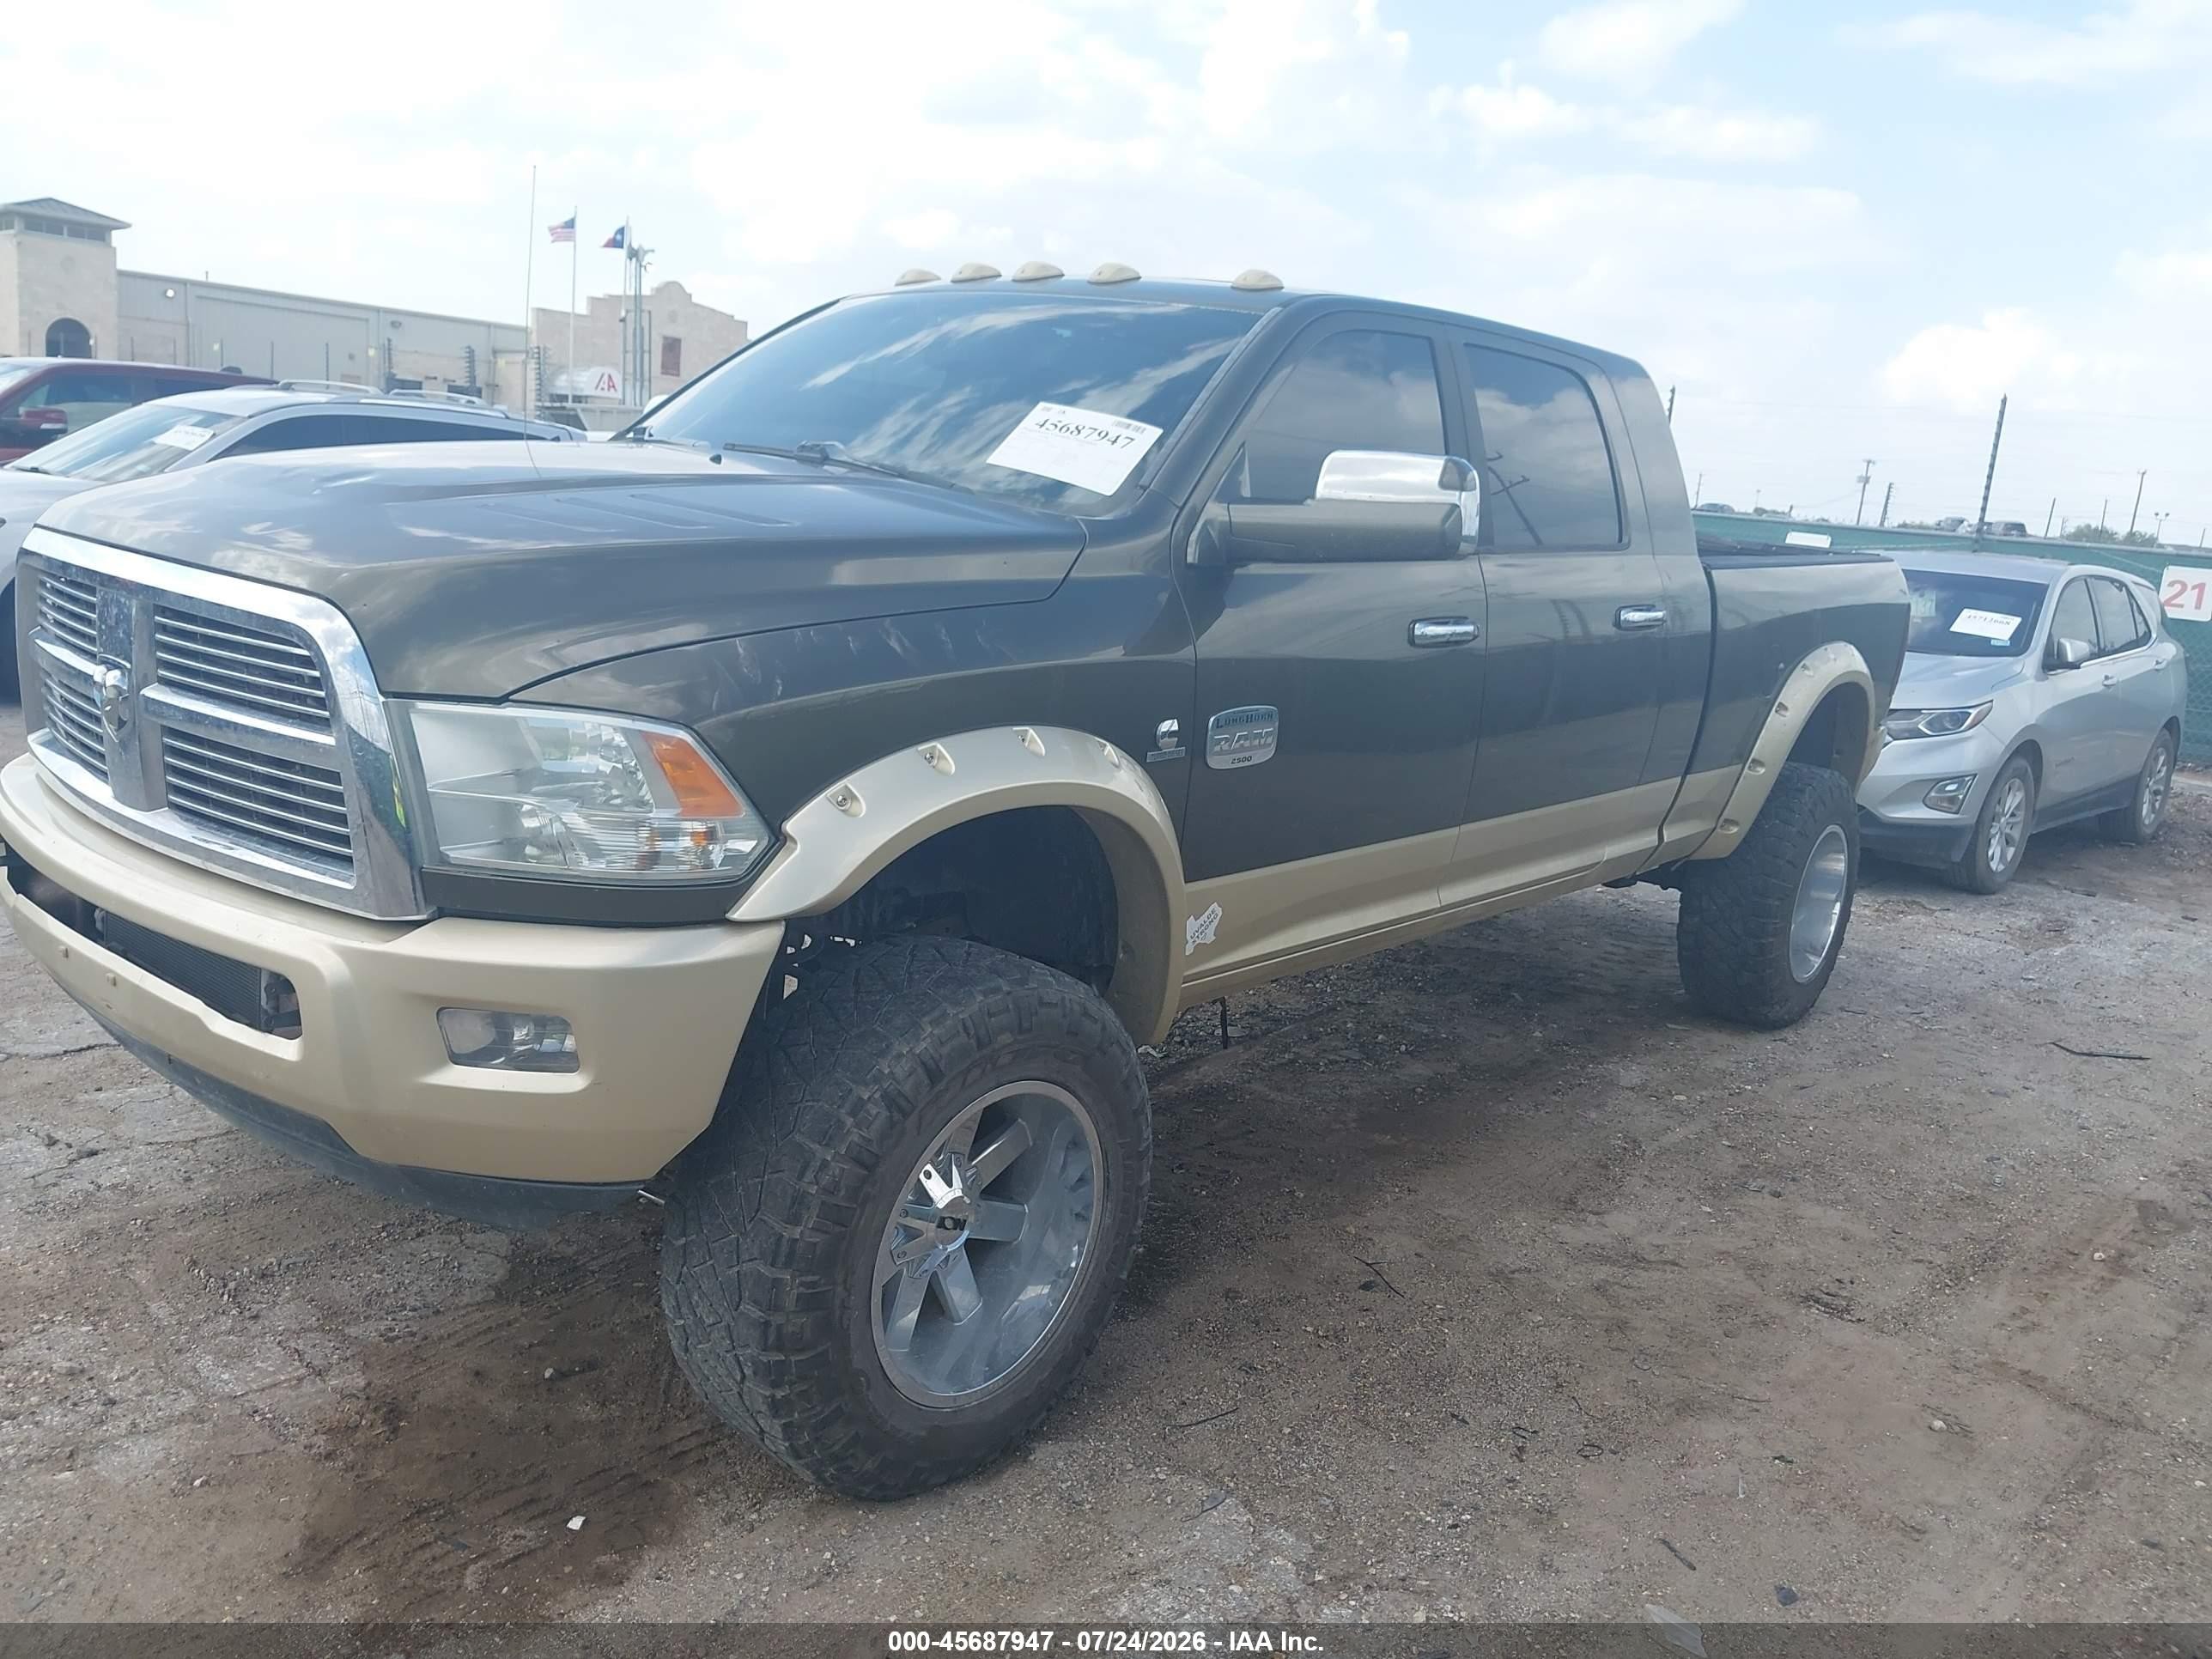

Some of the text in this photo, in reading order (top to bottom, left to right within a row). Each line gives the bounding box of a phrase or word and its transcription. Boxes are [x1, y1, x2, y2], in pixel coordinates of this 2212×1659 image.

[1035, 417, 1136, 449] 45687947
[2163, 580, 2206, 611] 21
[1212, 727, 1275, 752] RAM
[1231, 755, 1253, 765] 2500
[1189, 908, 1217, 939] UVALDE
[1192, 913, 1218, 944] STRONG
